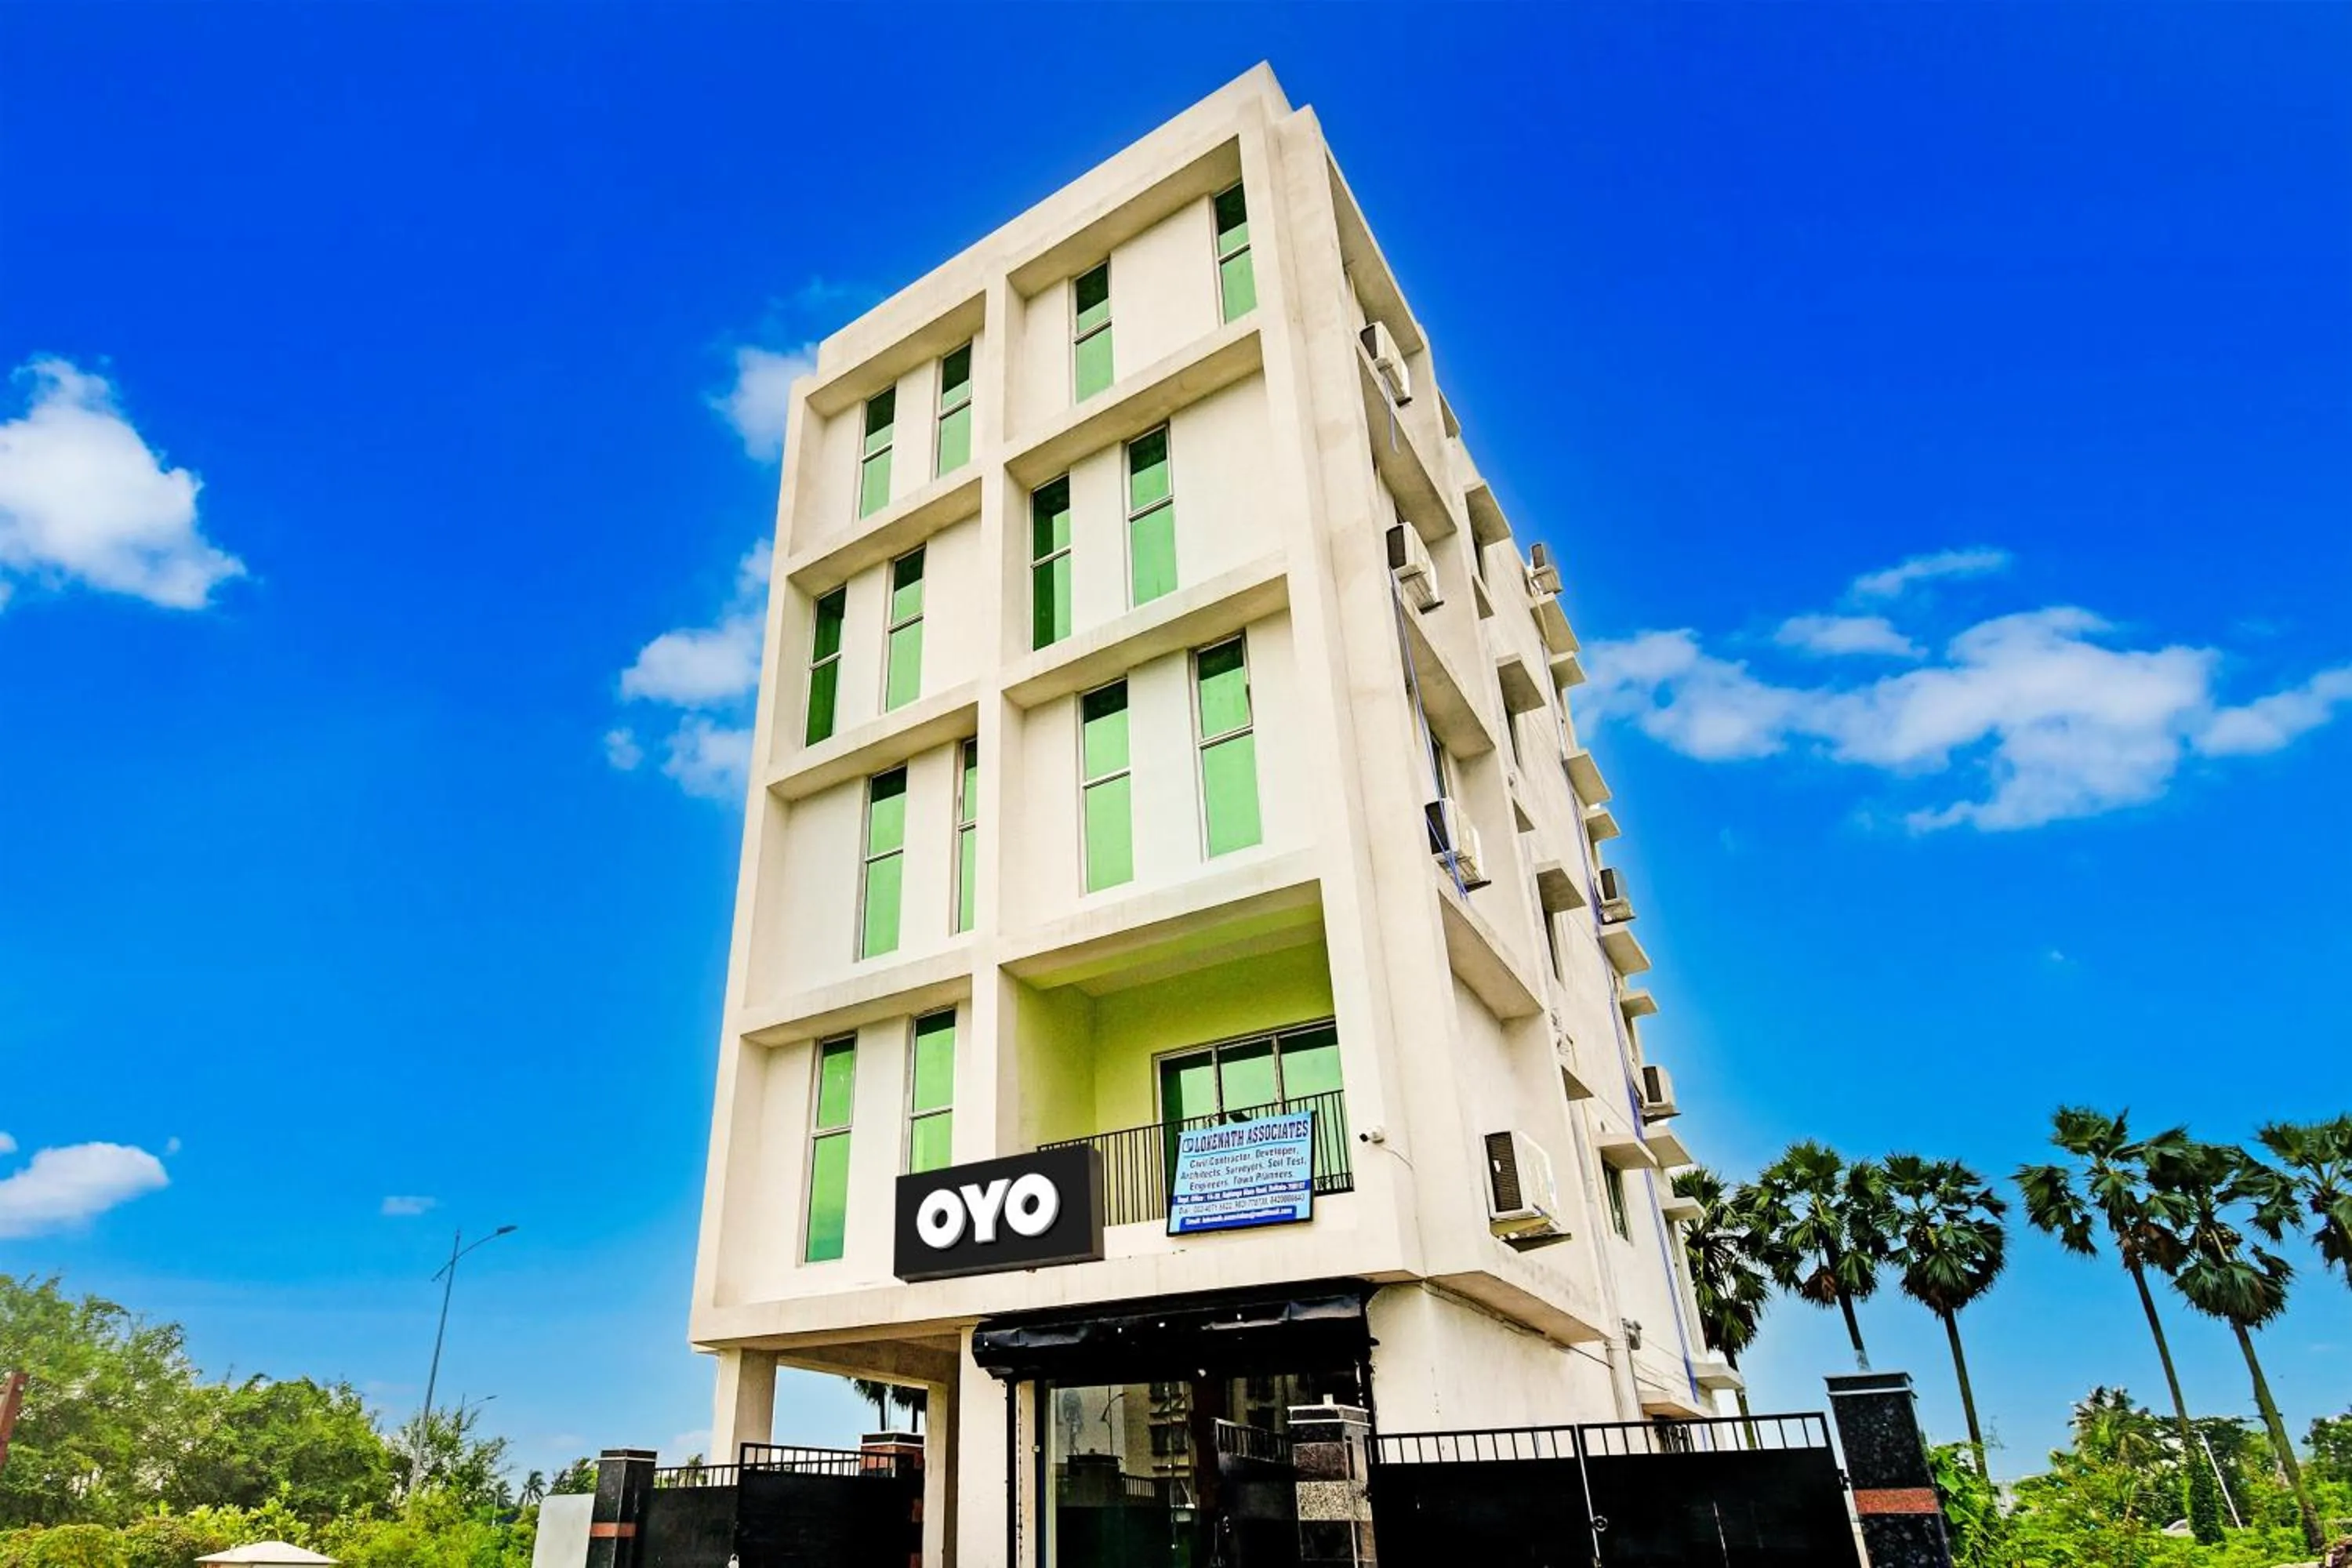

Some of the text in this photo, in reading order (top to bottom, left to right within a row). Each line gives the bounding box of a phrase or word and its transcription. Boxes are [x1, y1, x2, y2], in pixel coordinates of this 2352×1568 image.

[1195, 1120, 1308, 1152] LOKENATH ASSOCIATES
[1189, 1159, 1208, 1168] Civil
[1268, 1156, 1283, 1167] Soil
[1233, 1176, 1254, 1185] Town
[916, 1173, 1060, 1249] OYO
